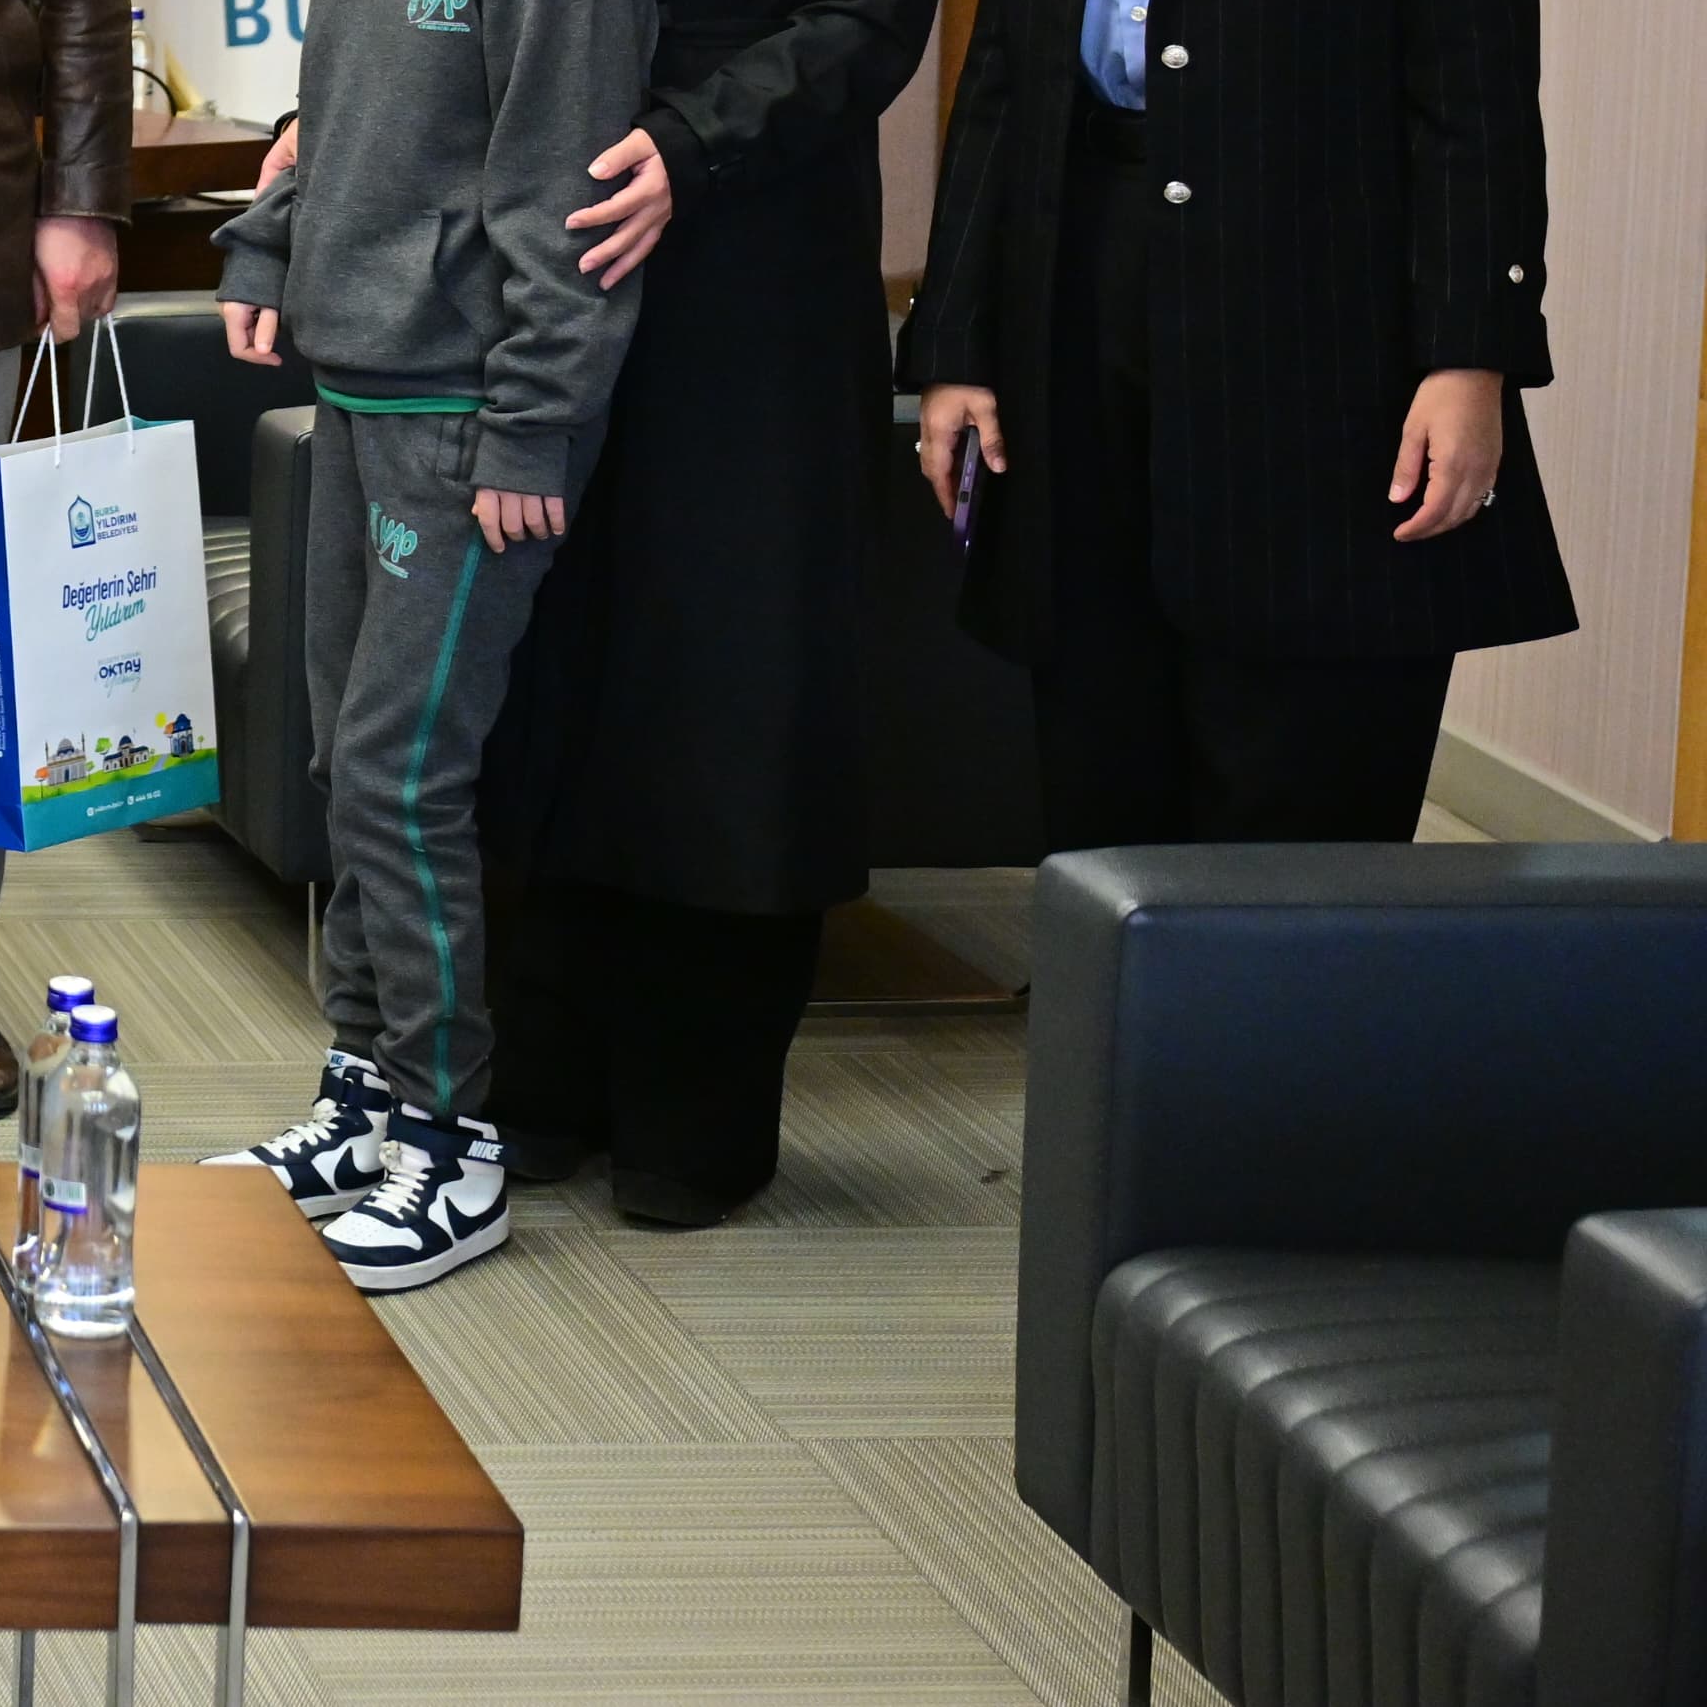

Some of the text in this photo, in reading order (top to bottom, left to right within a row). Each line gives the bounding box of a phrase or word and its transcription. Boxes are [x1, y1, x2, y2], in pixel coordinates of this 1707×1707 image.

[96, 511, 137, 530] YILDIRIM
[62, 565, 157, 610] Değerlerin Şehri
[99, 657, 141, 679] OKTAY
[467, 1140, 504, 1162] NIKE
